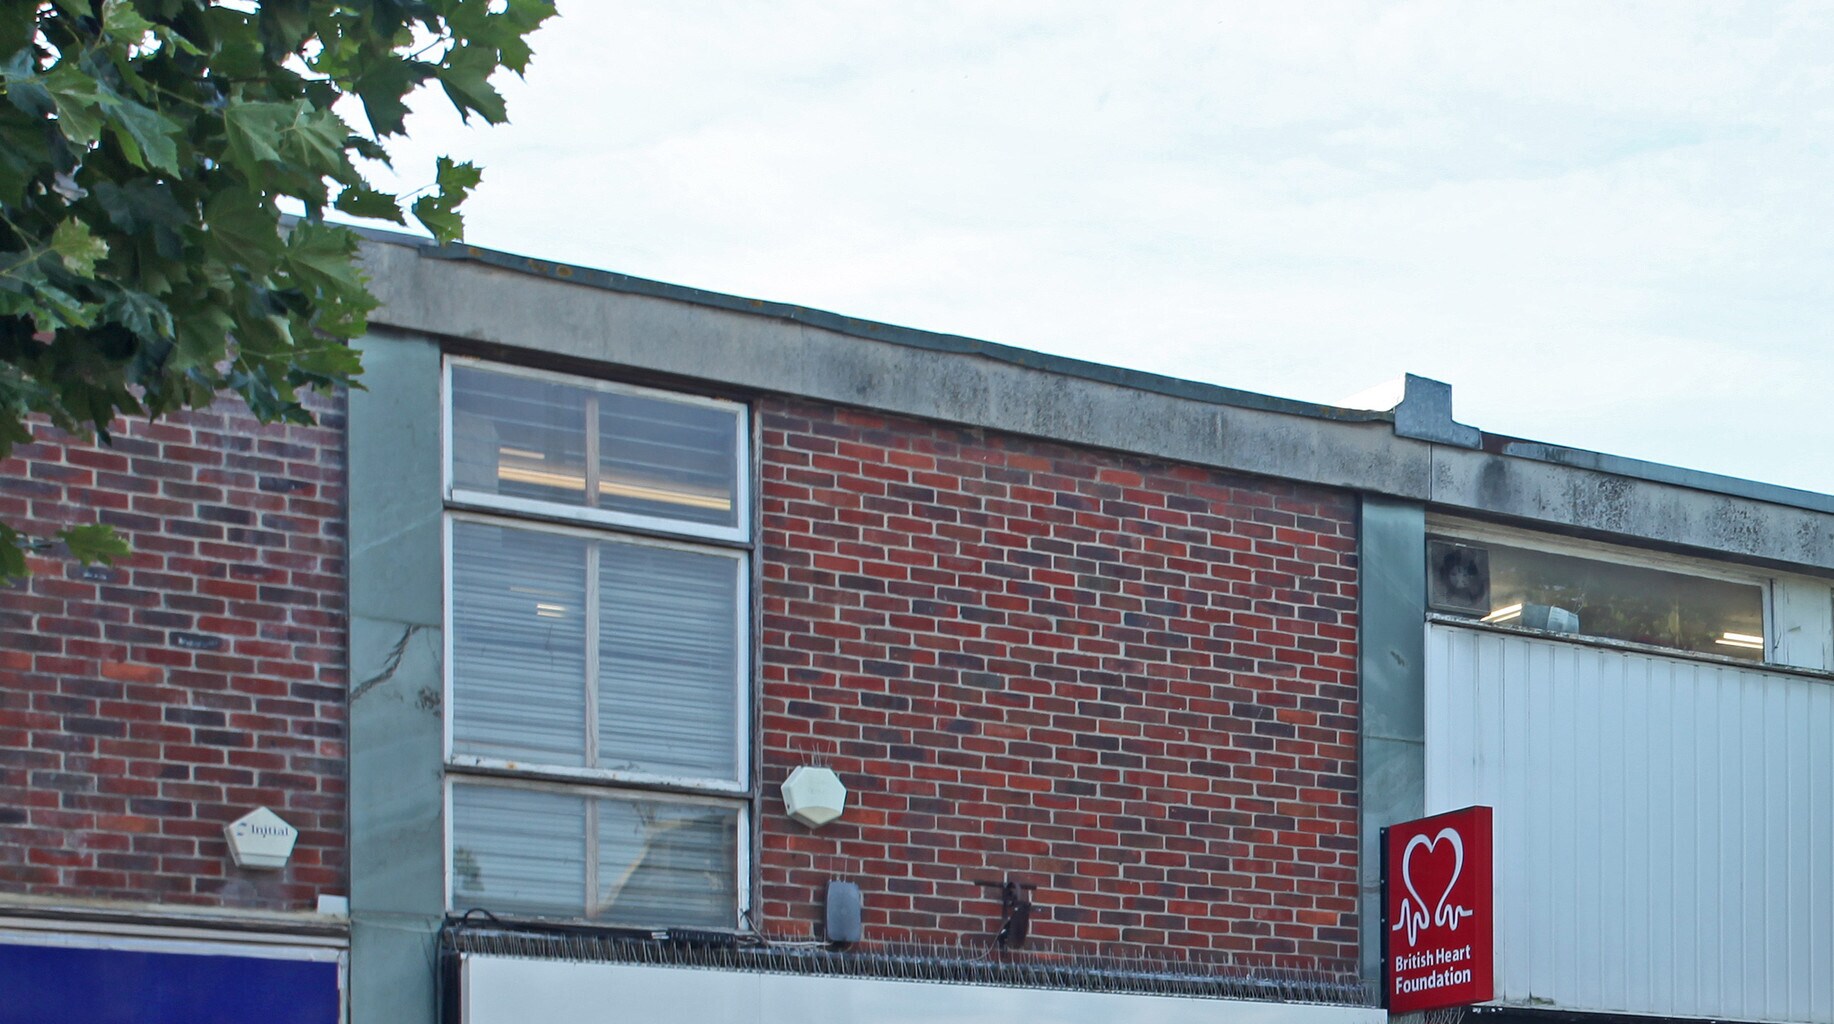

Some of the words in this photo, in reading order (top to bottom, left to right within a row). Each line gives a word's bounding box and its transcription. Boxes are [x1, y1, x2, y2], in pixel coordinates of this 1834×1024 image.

[1395, 948, 1434, 972] British
[1435, 944, 1471, 966] Heart
[1395, 966, 1471, 995] Foundation
